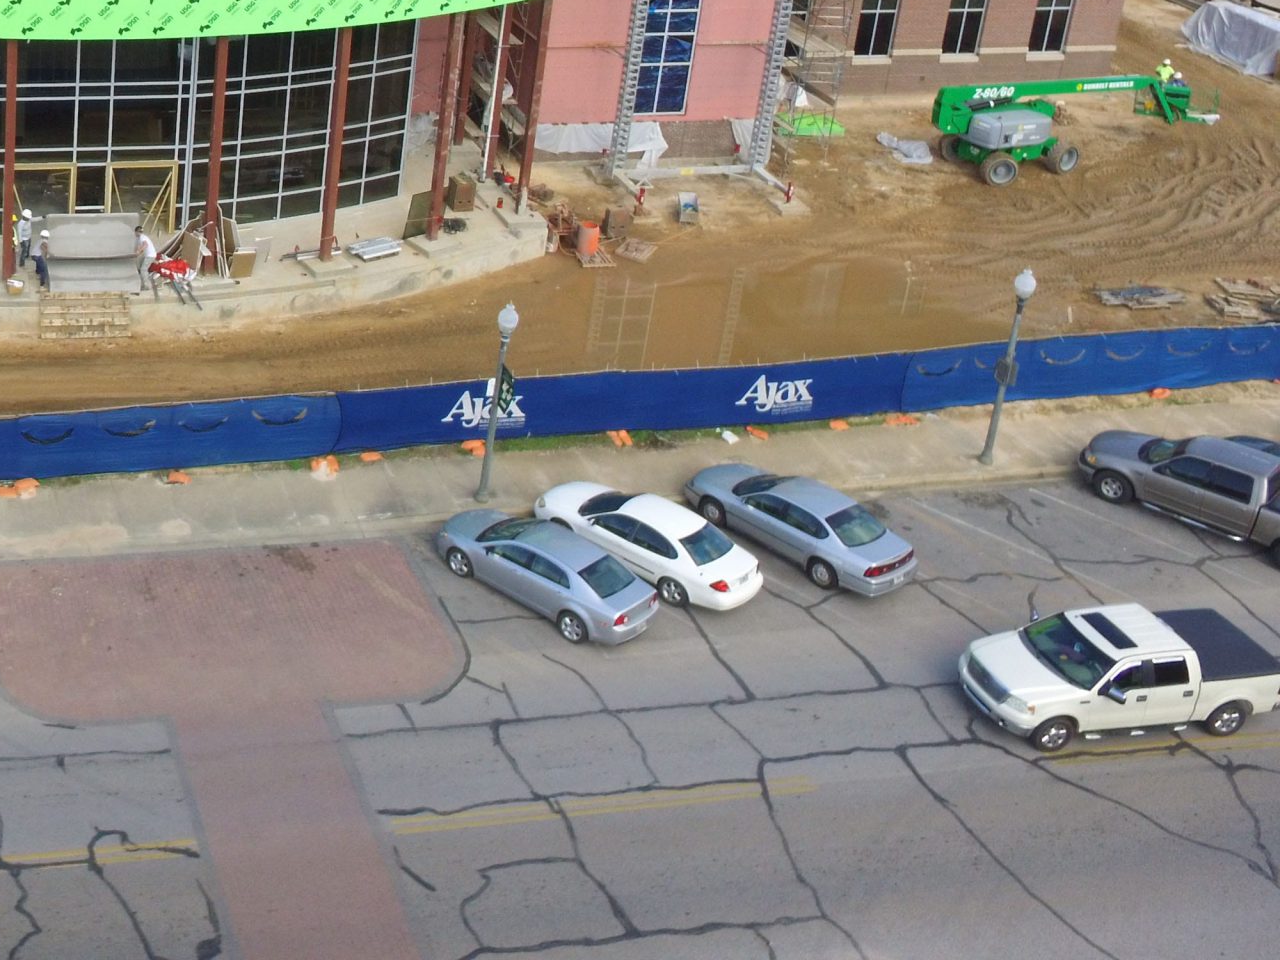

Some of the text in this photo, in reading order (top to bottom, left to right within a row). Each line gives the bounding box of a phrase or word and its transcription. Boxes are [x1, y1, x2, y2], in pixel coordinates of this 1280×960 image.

[1, 5, 13, 15] USG
[49, 6, 61, 16] USG
[98, 6, 110, 16] USG
[180, 4, 192, 14] USG
[226, 2, 238, 12] USG
[244, 1, 255, 11] USG
[352, 4, 363, 14] USG
[271, 10, 282, 20] USG
[314, 7, 325, 17] USG
[31, 16, 42, 27] USG
[79, 17, 91, 27] USG
[127, 16, 139, 27] USG
[162, 16, 173, 26] USG
[208, 14, 219, 24] USG
[972, 86, 1015, 99] Z-80/60
[735, 374, 813, 412] Ajax
